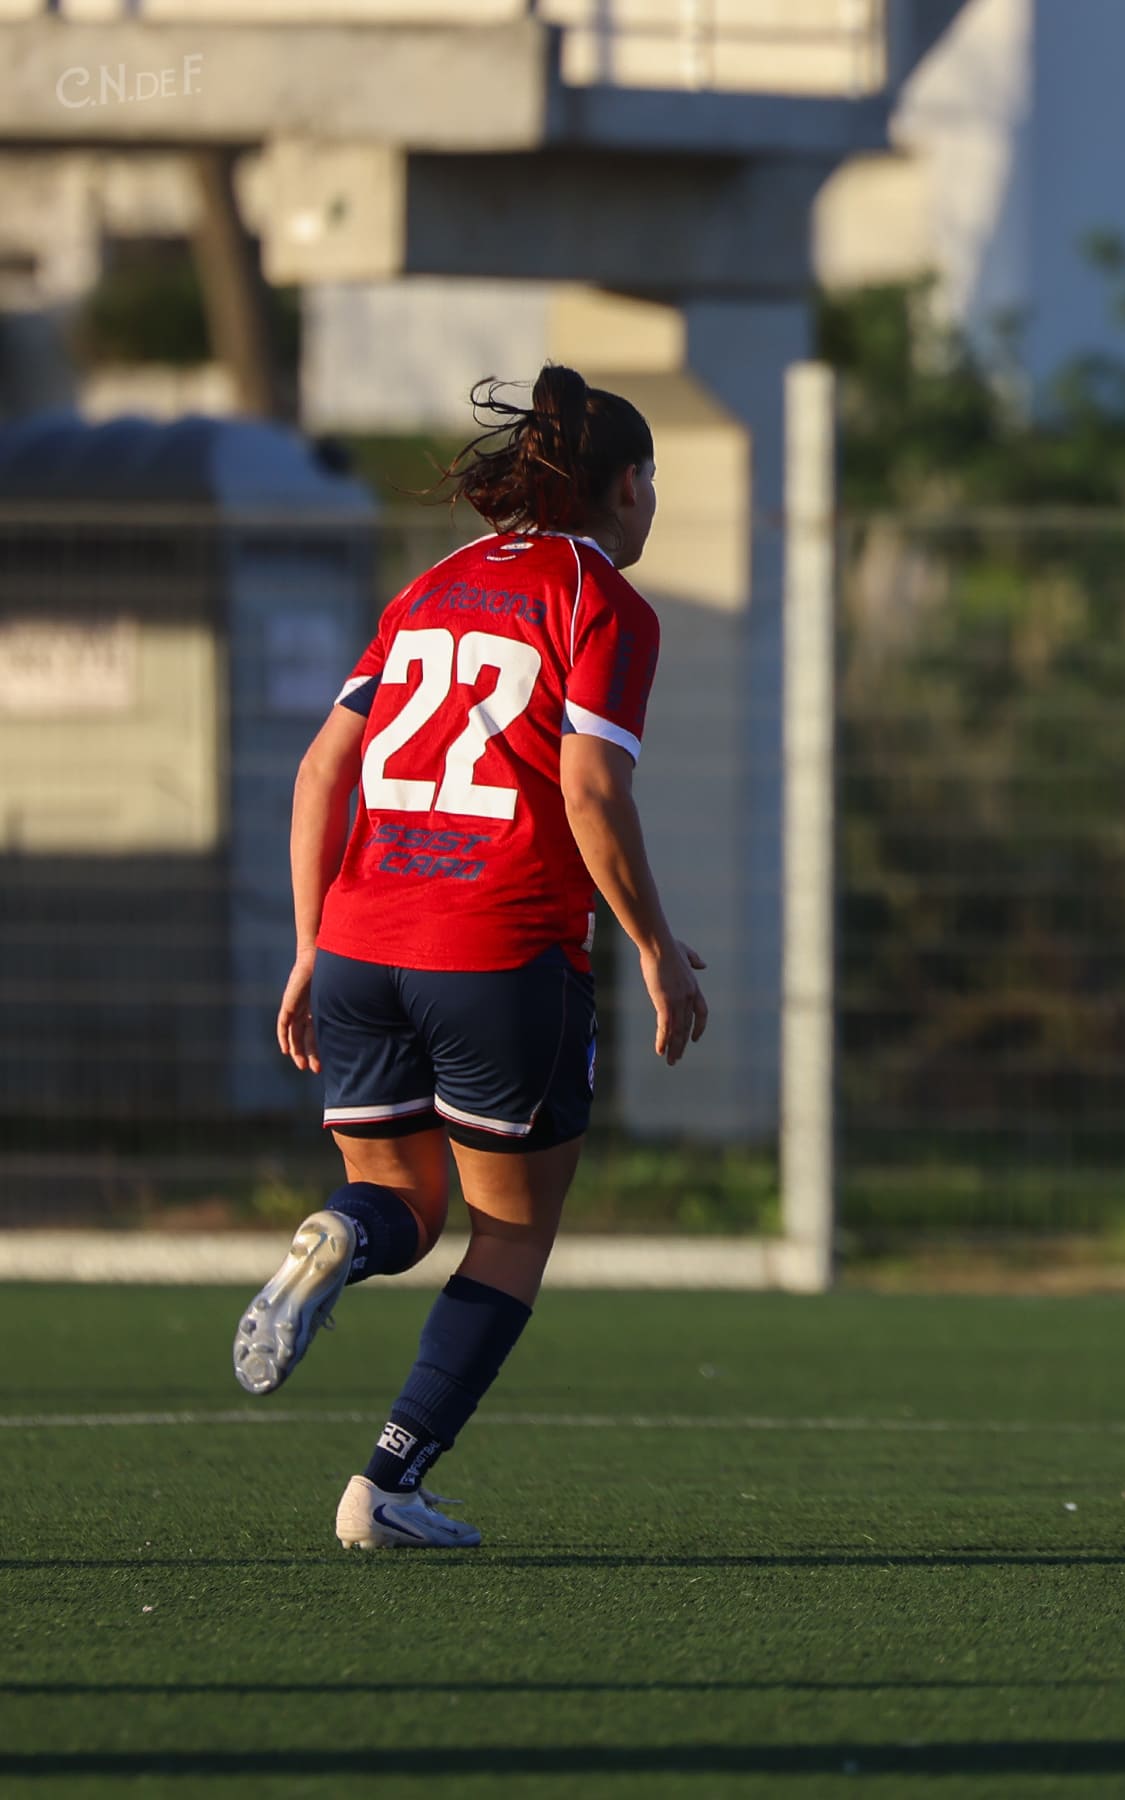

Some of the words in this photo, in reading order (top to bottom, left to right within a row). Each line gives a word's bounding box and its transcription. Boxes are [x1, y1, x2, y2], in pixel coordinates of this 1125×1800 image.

[438, 582, 547, 625] Rexona
[362, 628, 541, 820] 22
[379, 851, 486, 881] CARD
